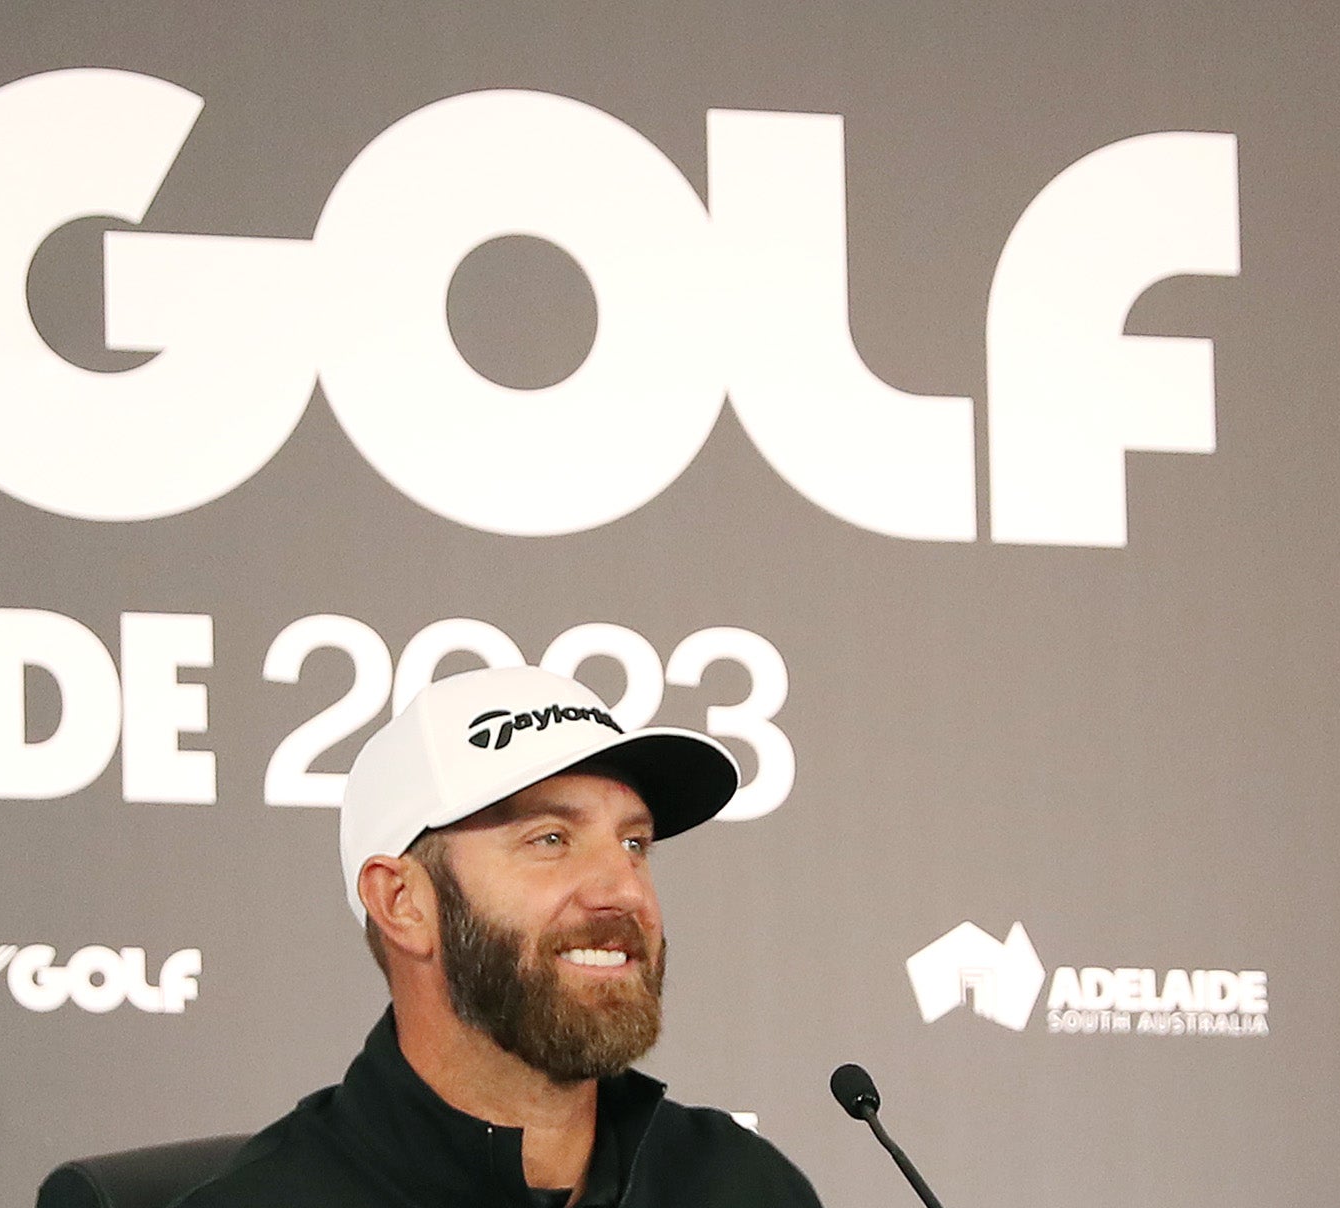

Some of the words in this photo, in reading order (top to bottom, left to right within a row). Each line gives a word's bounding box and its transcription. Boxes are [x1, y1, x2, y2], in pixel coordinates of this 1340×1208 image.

[468, 704, 626, 751] Taylor
[7, 944, 202, 1014] GOLF
[1047, 966, 1269, 1014] ADELAIDE
[1047, 1008, 1131, 1034] SOUTH
[1136, 1011, 1269, 1037] AUSTRALIA
